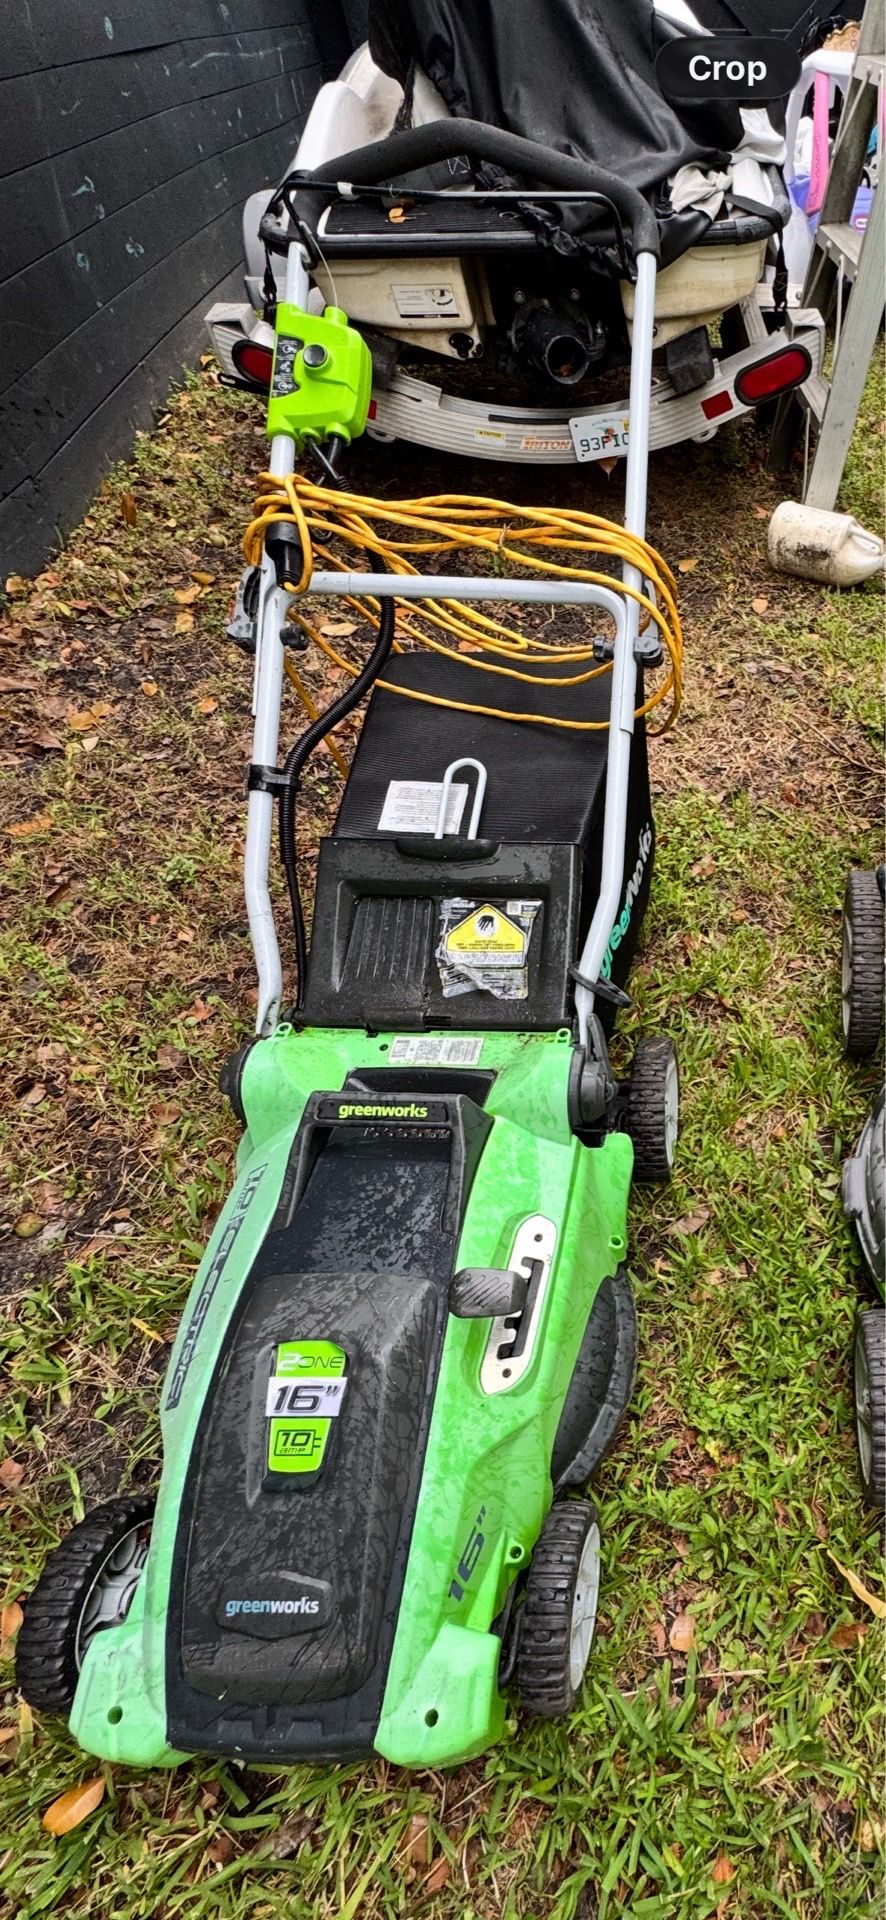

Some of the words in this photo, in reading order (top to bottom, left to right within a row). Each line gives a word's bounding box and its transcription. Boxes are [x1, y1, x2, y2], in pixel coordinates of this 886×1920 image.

[338, 1103, 428, 1119] greenworks
[168, 1228, 237, 1401] ELECTRIC
[281, 1432, 311, 1447] 10
[225, 1596, 319, 1617] greenworks
